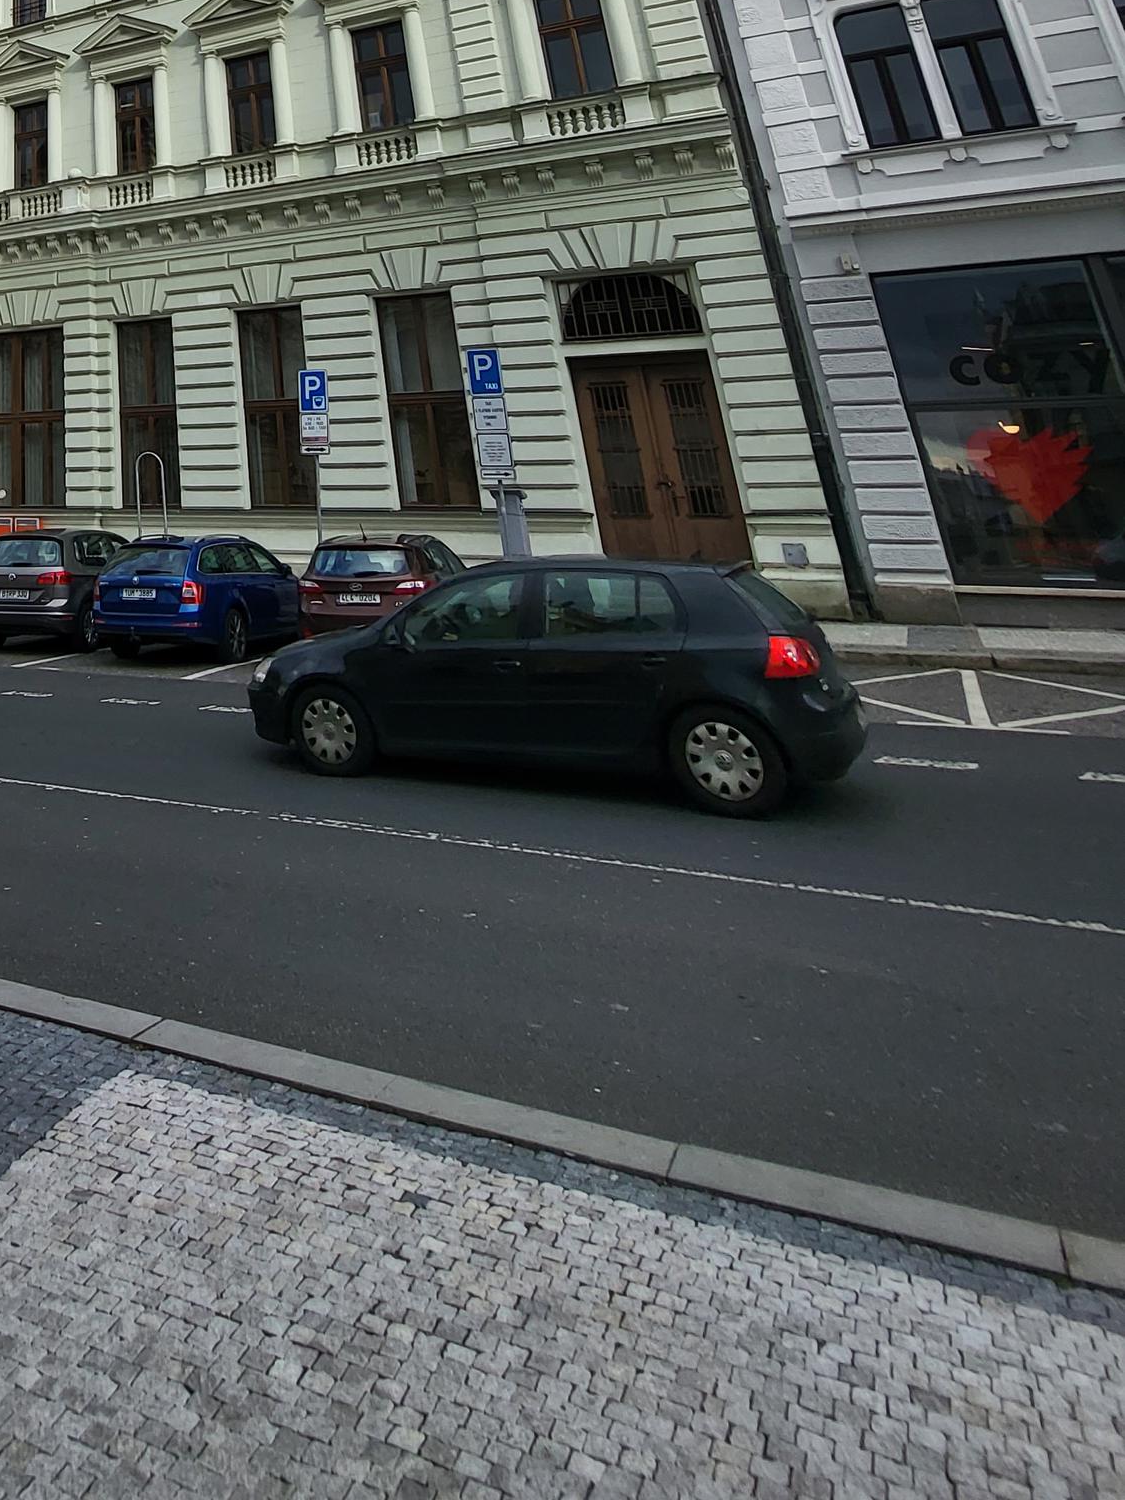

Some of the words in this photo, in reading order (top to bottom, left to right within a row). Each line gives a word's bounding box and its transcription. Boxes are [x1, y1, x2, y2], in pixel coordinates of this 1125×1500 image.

[473, 354, 492, 380] P
[949, 350, 1111, 394] COZY
[304, 376, 321, 400] P
